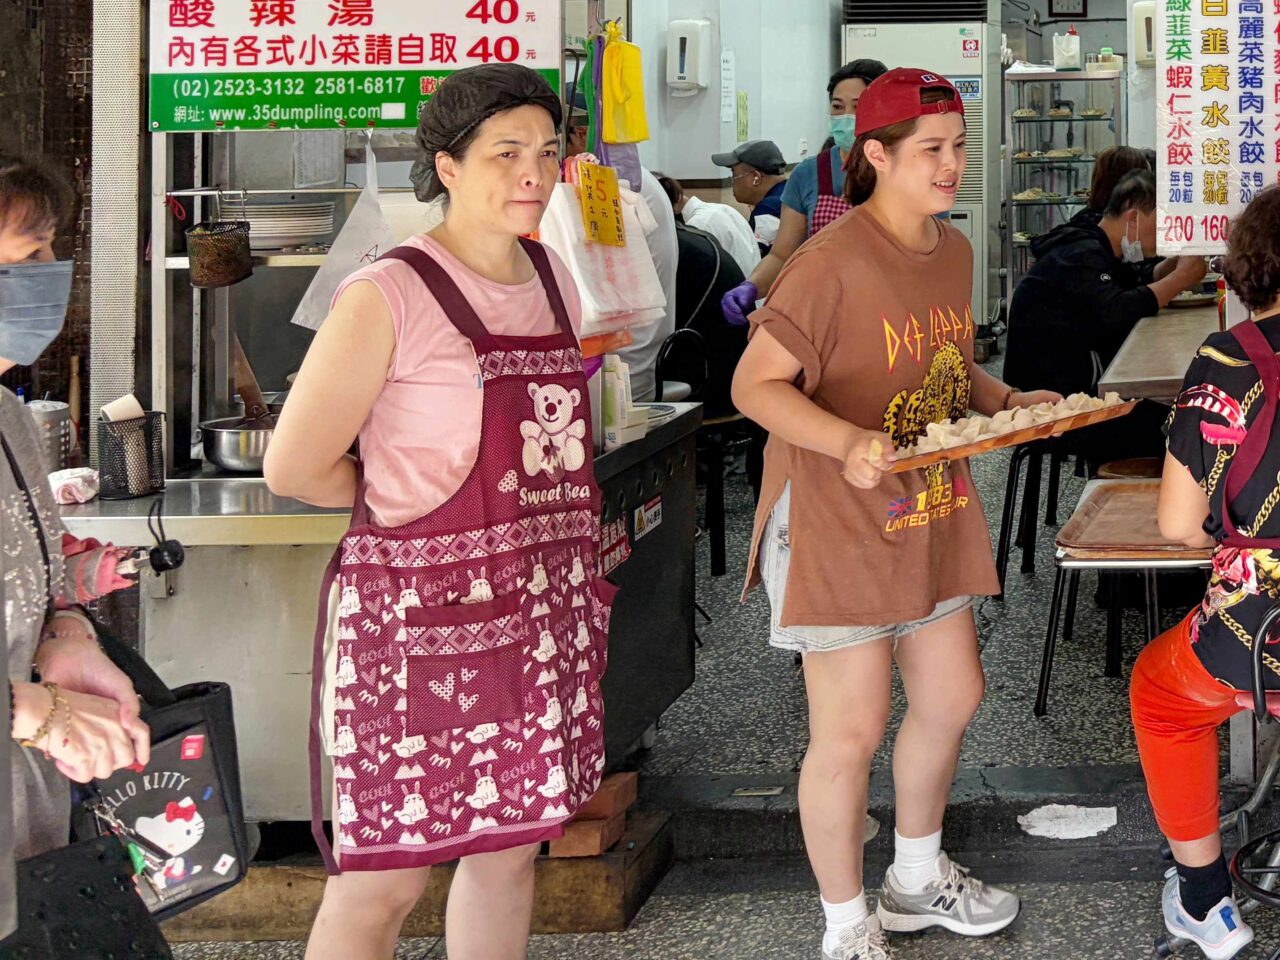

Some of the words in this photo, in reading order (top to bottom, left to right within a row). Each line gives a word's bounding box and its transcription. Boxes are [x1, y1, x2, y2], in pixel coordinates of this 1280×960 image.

[525, 11, 536, 22] 元
[168, 33, 458, 67] 內有各式小菜請自取
[466, 36, 519, 63] 40
[525, 48, 536, 60] 元
[314, 76, 406, 96] 2581-6817
[1169, 171, 1193, 187] 每包
[1203, 170, 1229, 187] 每包
[1169, 188, 1194, 203] 20粒
[1202, 189, 1229, 205] 20粒
[1163, 215, 1194, 242] 200
[1201, 214, 1229, 242] 160
[519, 482, 563, 507] Sweet
[143, 771, 191, 792] KITTY
